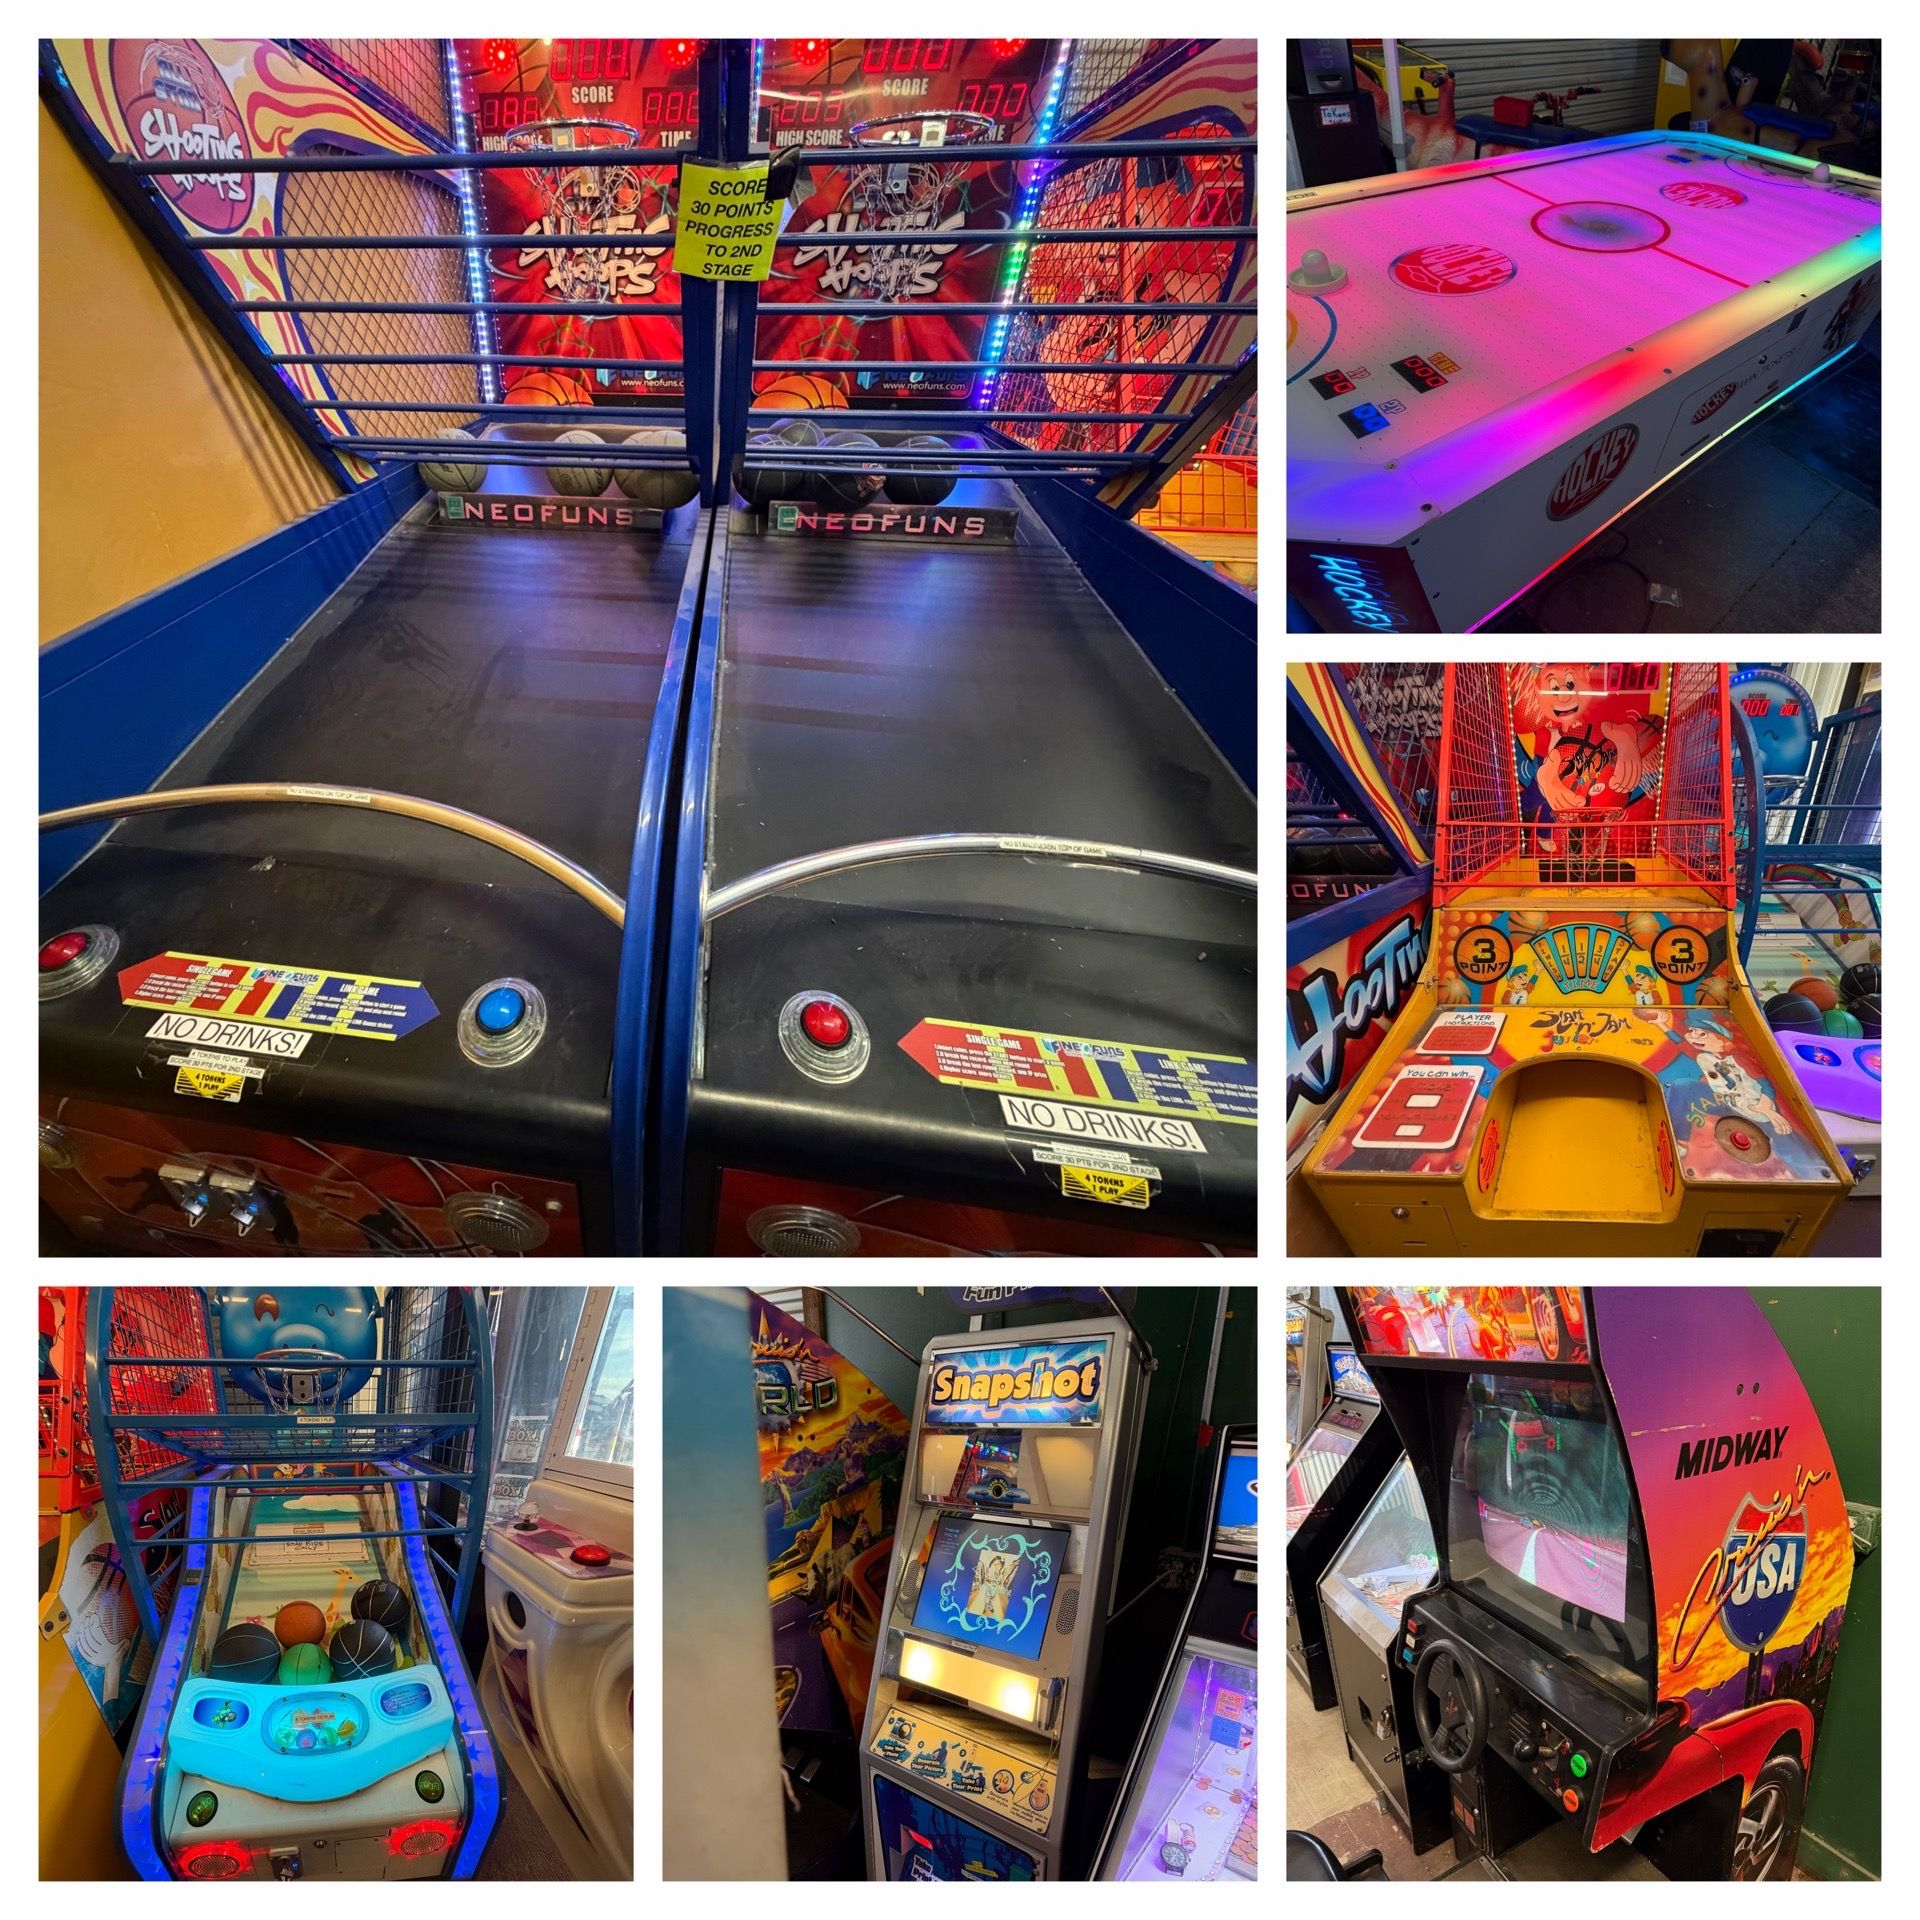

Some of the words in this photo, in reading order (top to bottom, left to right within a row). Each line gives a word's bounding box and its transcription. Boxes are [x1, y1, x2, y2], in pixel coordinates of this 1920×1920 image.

[571, 85, 615, 104] SCORE
[882, 78, 929, 97] SCORE
[140, 108, 245, 162] SHOOTING
[482, 135, 508, 151] HIGH
[776, 130, 804, 147] HIGH
[806, 129, 844, 146] SCORE
[708, 177, 768, 198] SCORE
[690, 199, 712, 217] 30
[713, 199, 774, 219] POINTS
[685, 219, 774, 239] PROGRESS
[706, 243, 729, 258] TO
[731, 242, 763, 258] 2ND
[701, 263, 754, 277] STAGE
[882, 381, 966, 391] www.neofuns.com
[464, 502, 633, 526] NEOFUNS
[796, 511, 986, 535] NEOFUNS
[1309, 553, 1400, 633] HOCKEY
[1472, 938, 1496, 963] 3
[1670, 938, 1694, 963] 3
[1459, 960, 1509, 975] POINT
[1657, 960, 1704, 975] POINT
[339, 983, 356, 994] LINK
[357, 985, 380, 997] GAME
[1563, 978, 1599, 990] TIME
[154, 1014, 198, 1039] NO
[198, 1021, 304, 1055] DRINKS!
[965, 1033, 995, 1046] SINGLE
[995, 1038, 1022, 1050] GAME
[169, 1056, 192, 1066] SCORE
[192, 1059, 199, 1067] 30
[200, 1060, 213, 1069] PTS
[214, 1062, 228, 1071] FOR
[227, 1064, 241, 1073] 2ND
[241, 1066, 263, 1077] STAGE
[195, 1051, 221, 1061] TOKENS
[231, 1056, 249, 1065] PLAY
[195, 1073, 200, 1081] 4
[201, 1074, 226, 1084] TOKENS
[1406, 1069, 1427, 1078] You
[1431, 1070, 1450, 1078] can
[202, 1082, 219, 1091] PLAY
[1007, 1098, 1056, 1128] NO
[1062, 1107, 1198, 1150] DRINKS!
[1035, 1152, 1064, 1162] SCORE
[1064, 1155, 1075, 1163] 30
[1076, 1157, 1092, 1166] PTS
[1093, 1160, 1111, 1169] FOR
[1112, 1163, 1128, 1172] 2ND
[1130, 1165, 1158, 1176] STAGE
[1085, 1174, 1091, 1182] 4
[1092, 1175, 1125, 1187] TOKENS
[1099, 1186, 1119, 1195] PLAY
[963, 1287, 1001, 1302] Fun
[934, 1360, 1098, 1409] Snapshot
[757, 1377, 838, 1415] RLD
[507, 1430, 541, 1441] BOX!
[1674, 1425, 1790, 1481] MIDWAY
[494, 1486, 525, 1498] BOX!
[1730, 1542, 1798, 1606] USA
